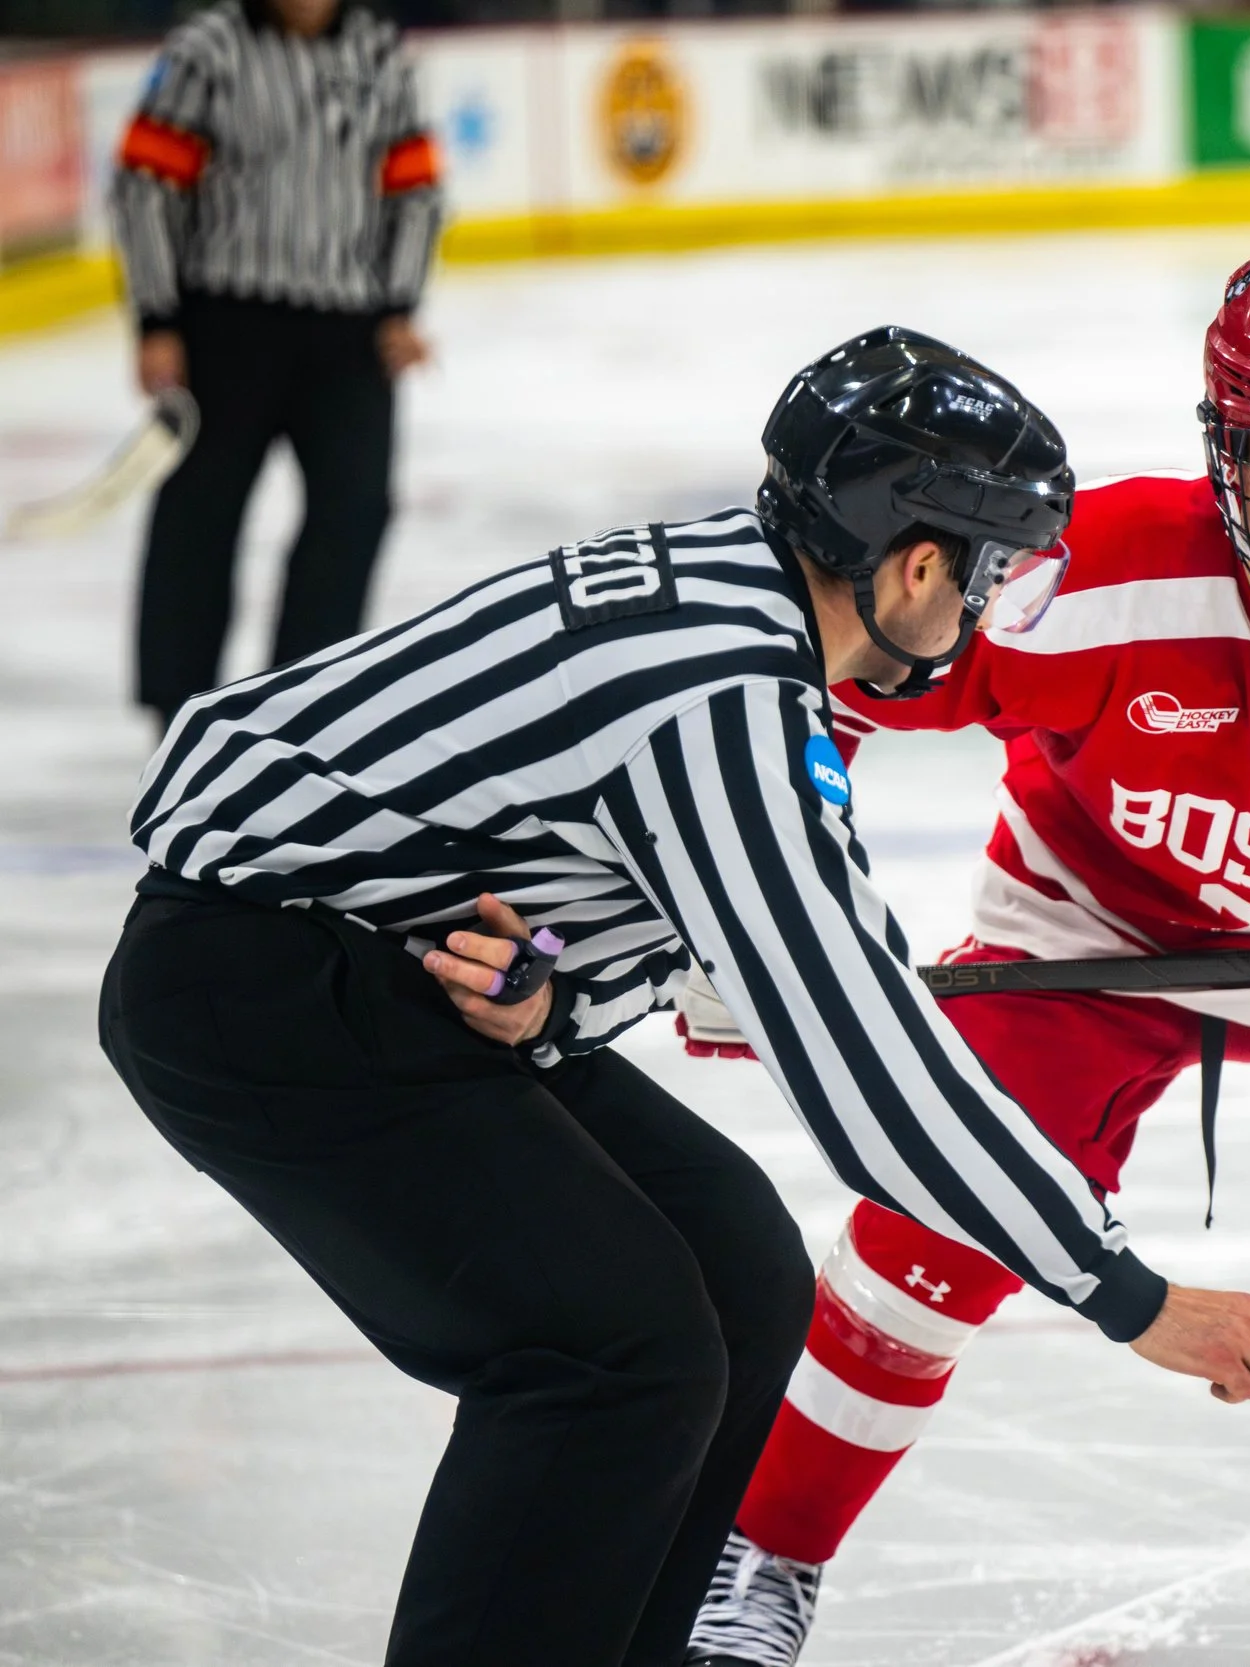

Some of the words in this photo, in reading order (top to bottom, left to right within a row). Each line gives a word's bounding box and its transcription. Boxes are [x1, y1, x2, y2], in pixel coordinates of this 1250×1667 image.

[1180, 710, 1236, 721] HOCKEY
[1176, 720, 1209, 730] EAST
[814, 761, 849, 795] NCAA
[919, 966, 1004, 988] OST
